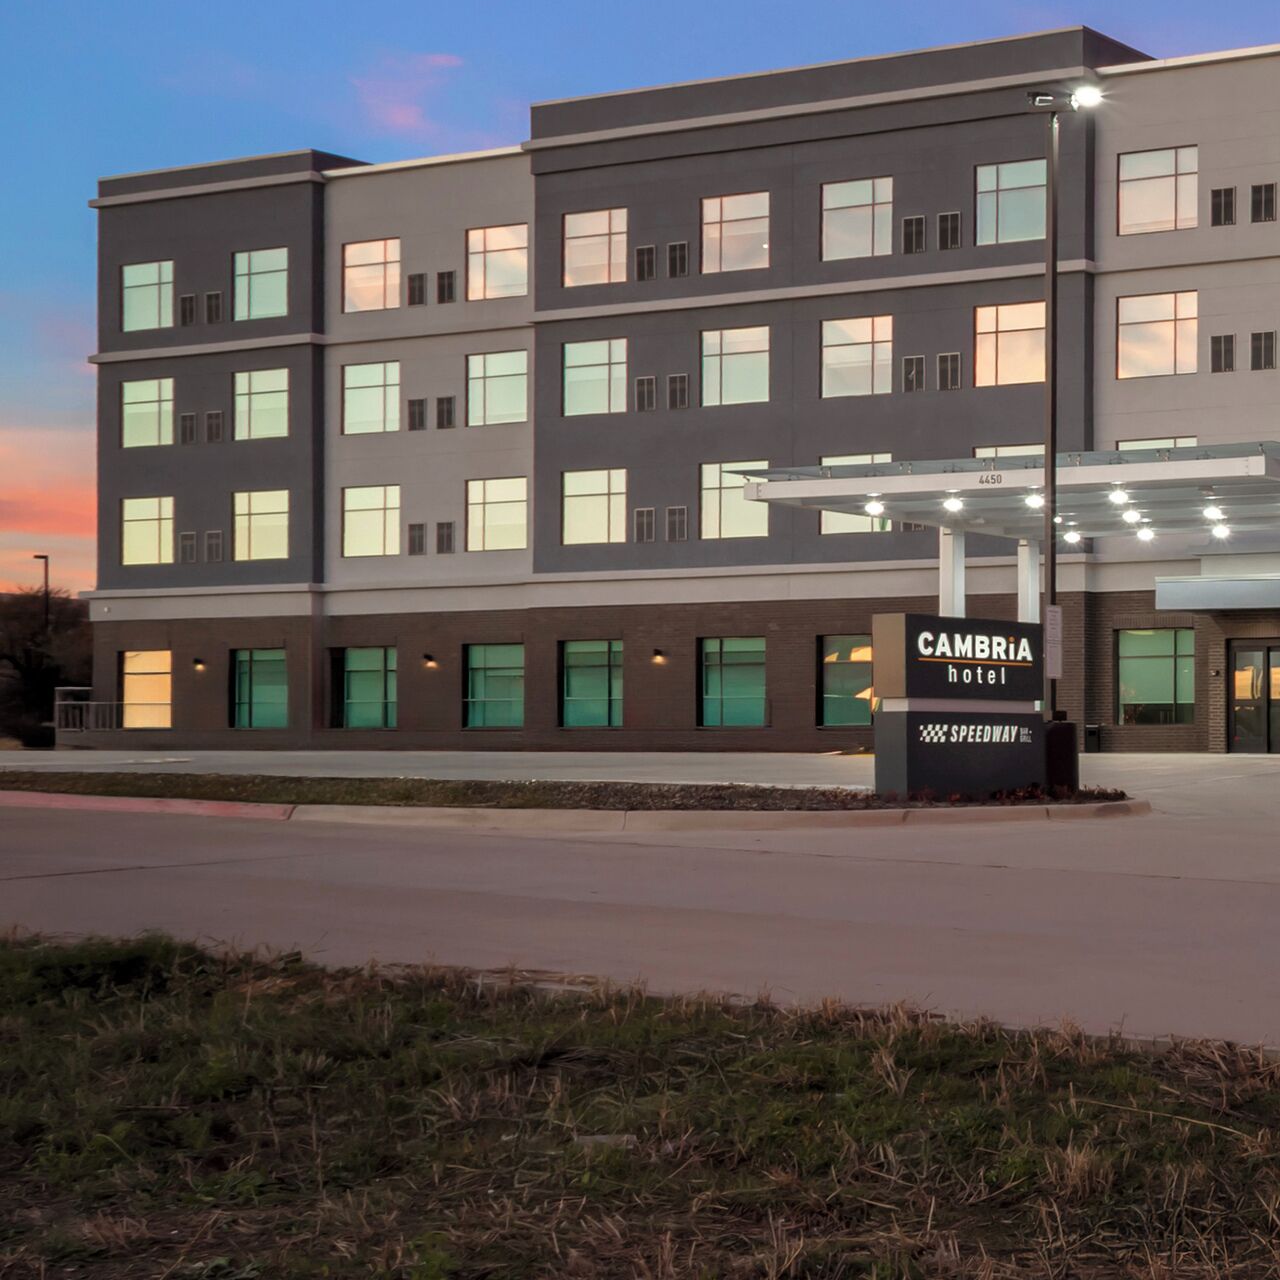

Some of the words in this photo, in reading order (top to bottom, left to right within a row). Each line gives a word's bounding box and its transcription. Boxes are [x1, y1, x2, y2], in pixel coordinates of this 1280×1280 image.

[978, 474, 1002, 485] 4450
[948, 664, 1006, 685] hotel
[950, 724, 1018, 743] SPEEDWAY
